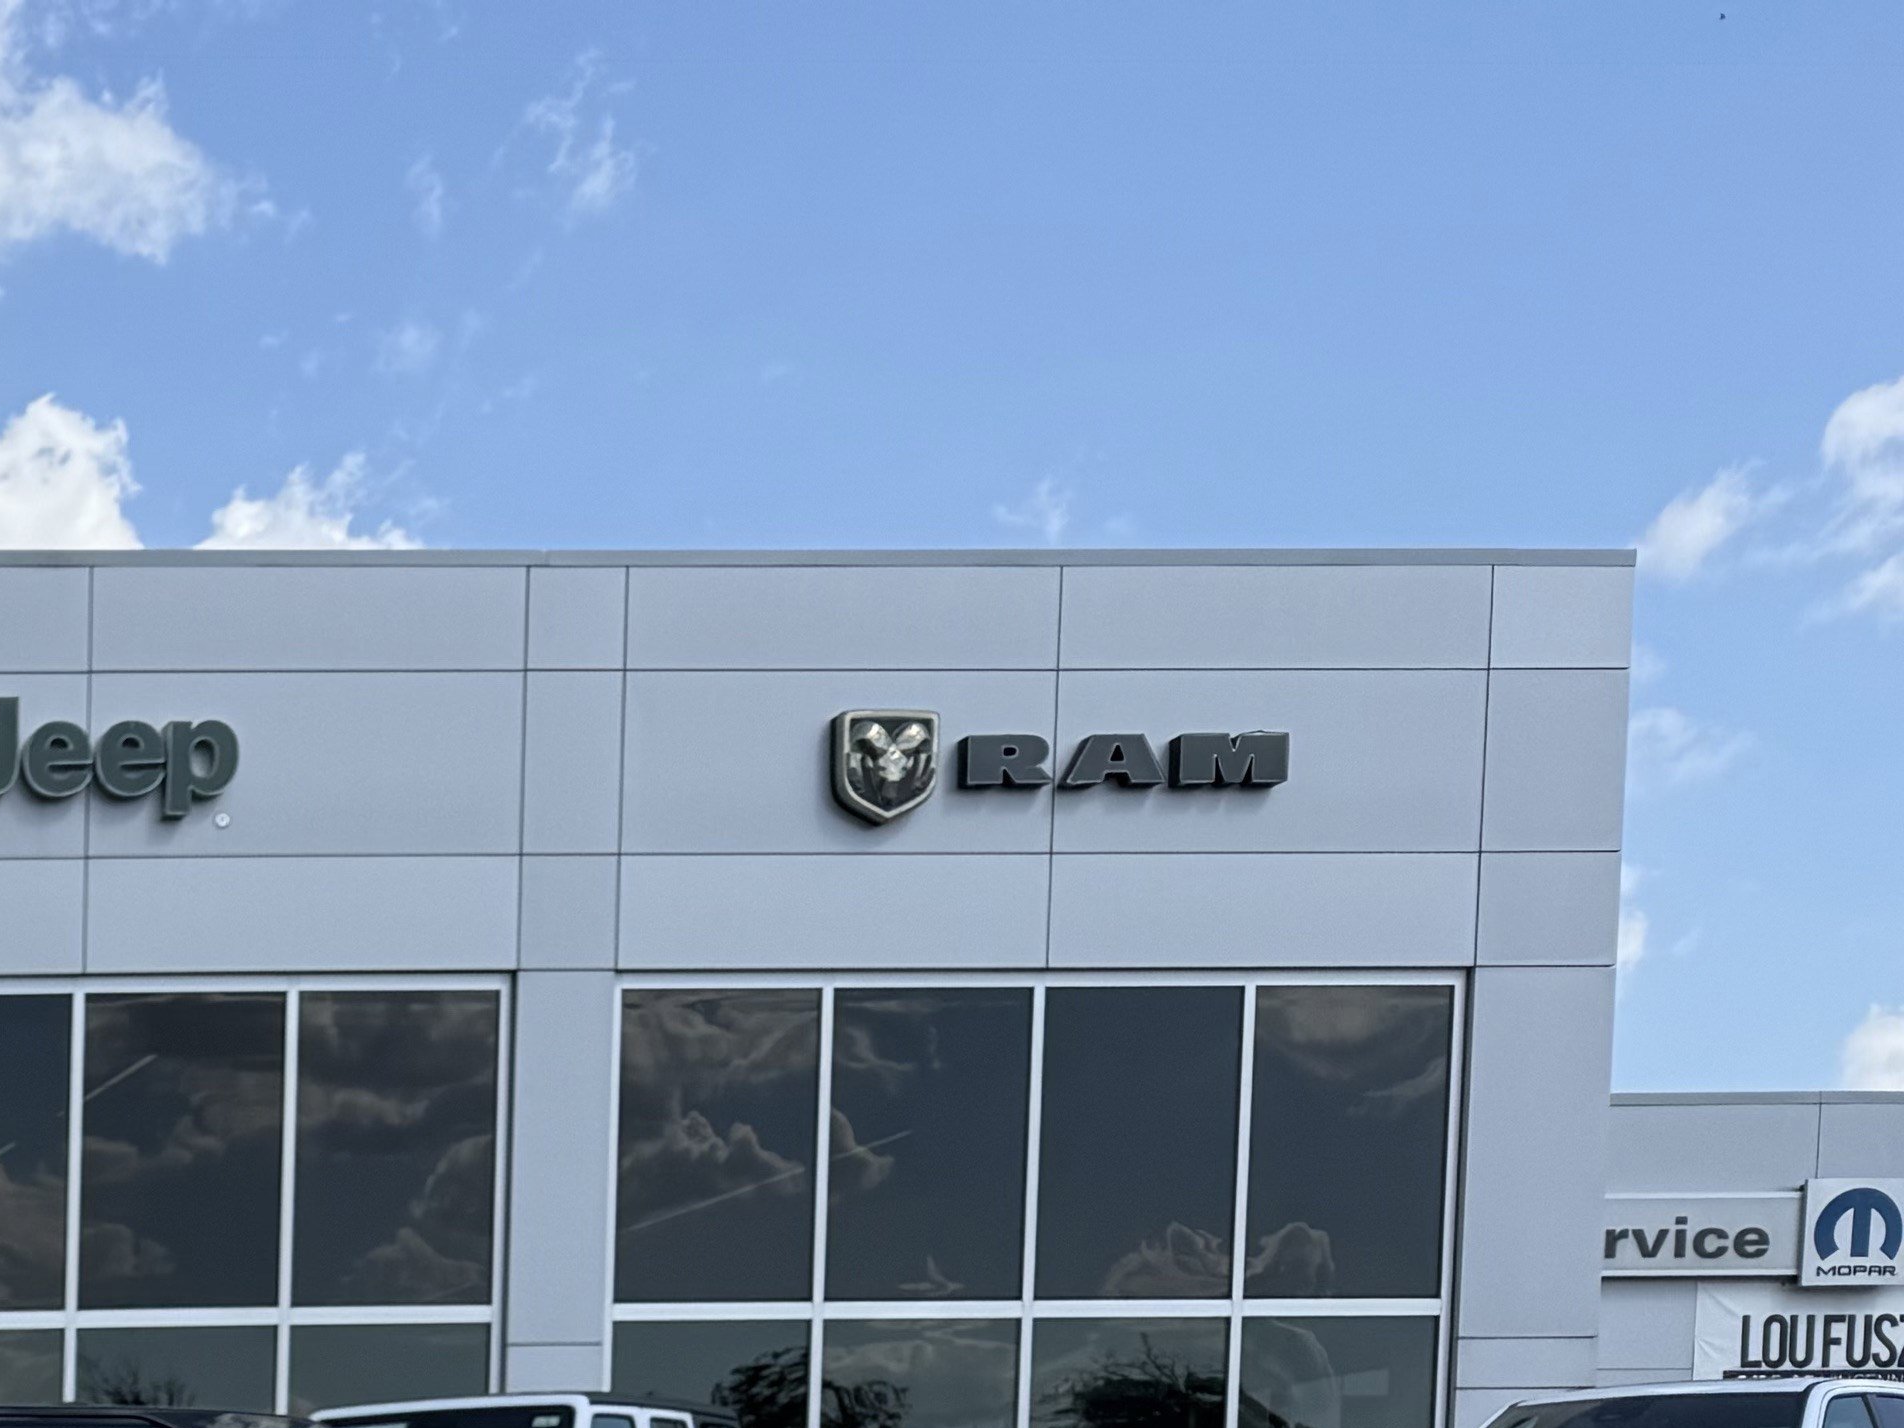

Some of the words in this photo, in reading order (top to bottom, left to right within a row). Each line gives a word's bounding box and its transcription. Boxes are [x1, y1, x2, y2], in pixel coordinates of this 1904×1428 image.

[957, 730, 1291, 788] RAM
[1815, 1264, 1898, 1278] MOPAR
[1740, 1313, 1816, 1369] LOU
[1821, 1313, 1904, 1369] FUS
